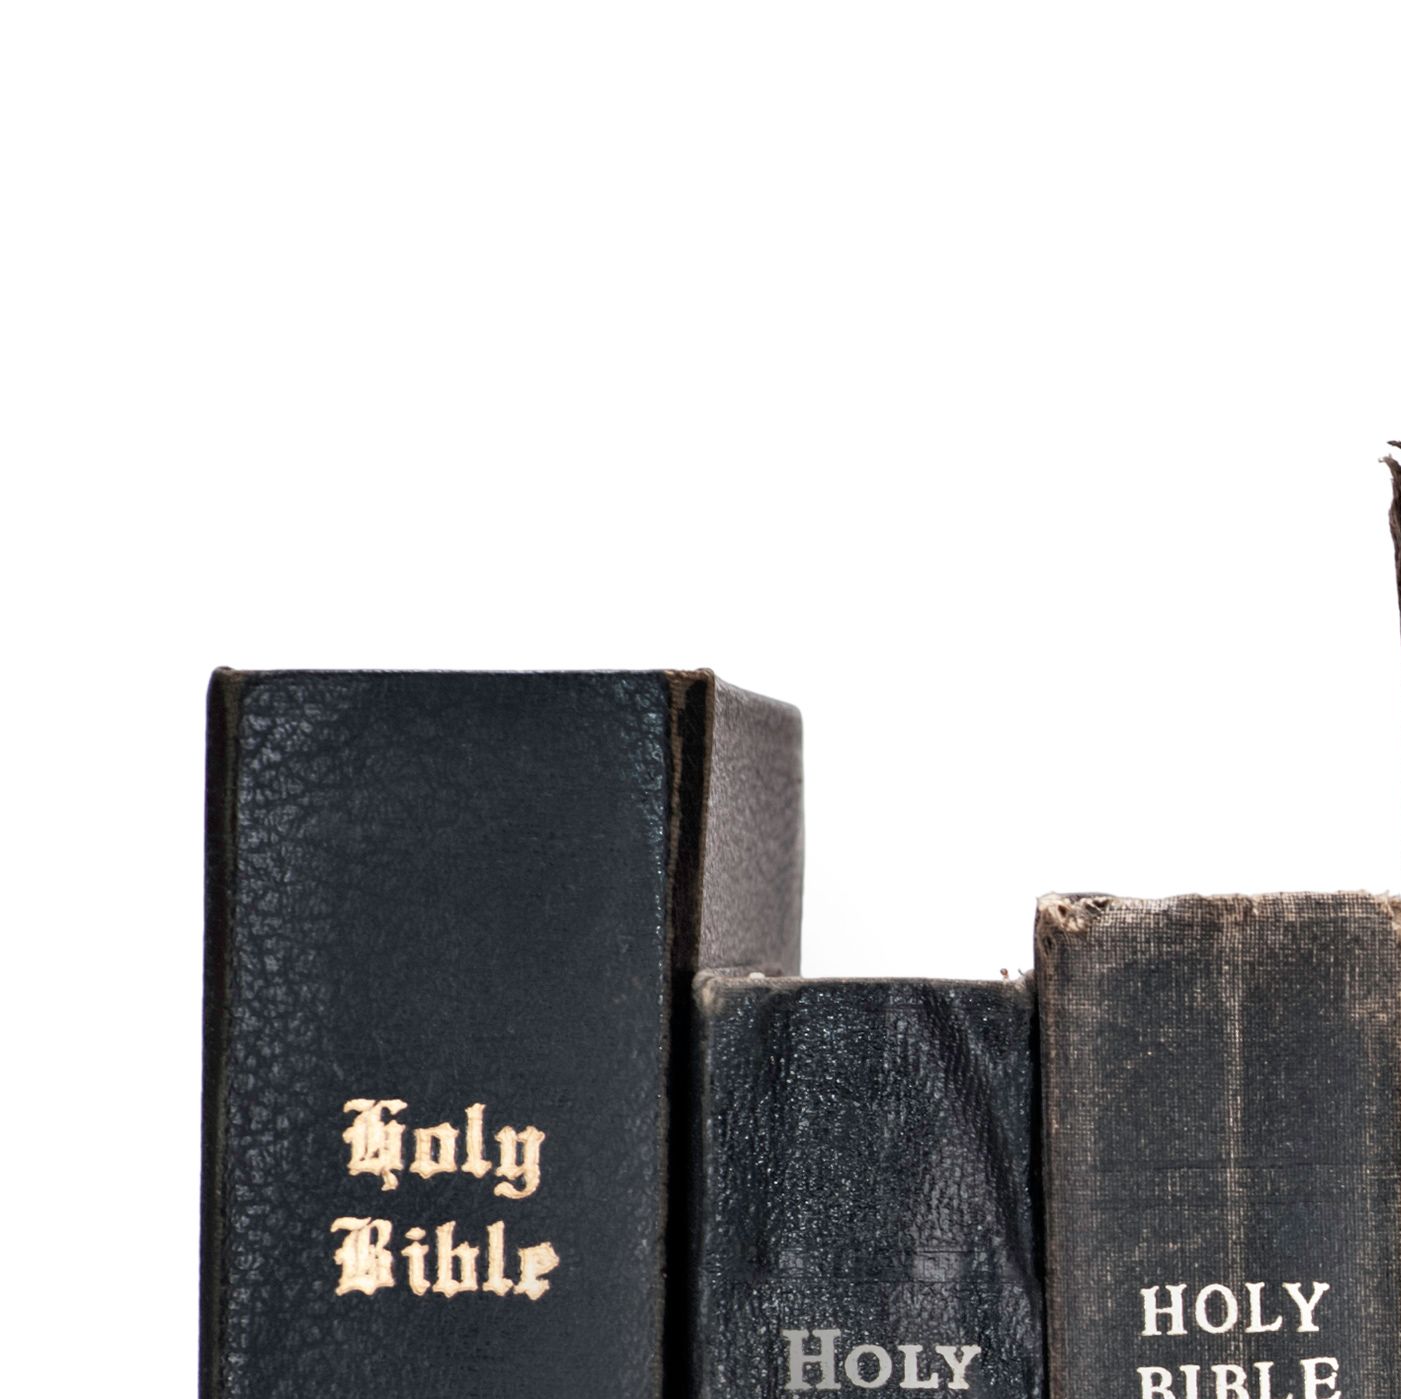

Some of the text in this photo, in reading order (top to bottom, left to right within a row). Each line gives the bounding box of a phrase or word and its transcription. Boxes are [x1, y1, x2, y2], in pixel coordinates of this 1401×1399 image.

[342, 1098, 546, 1199] Holy
[330, 1216, 561, 1300] Bible
[1140, 1282, 1330, 1336] HOLY
